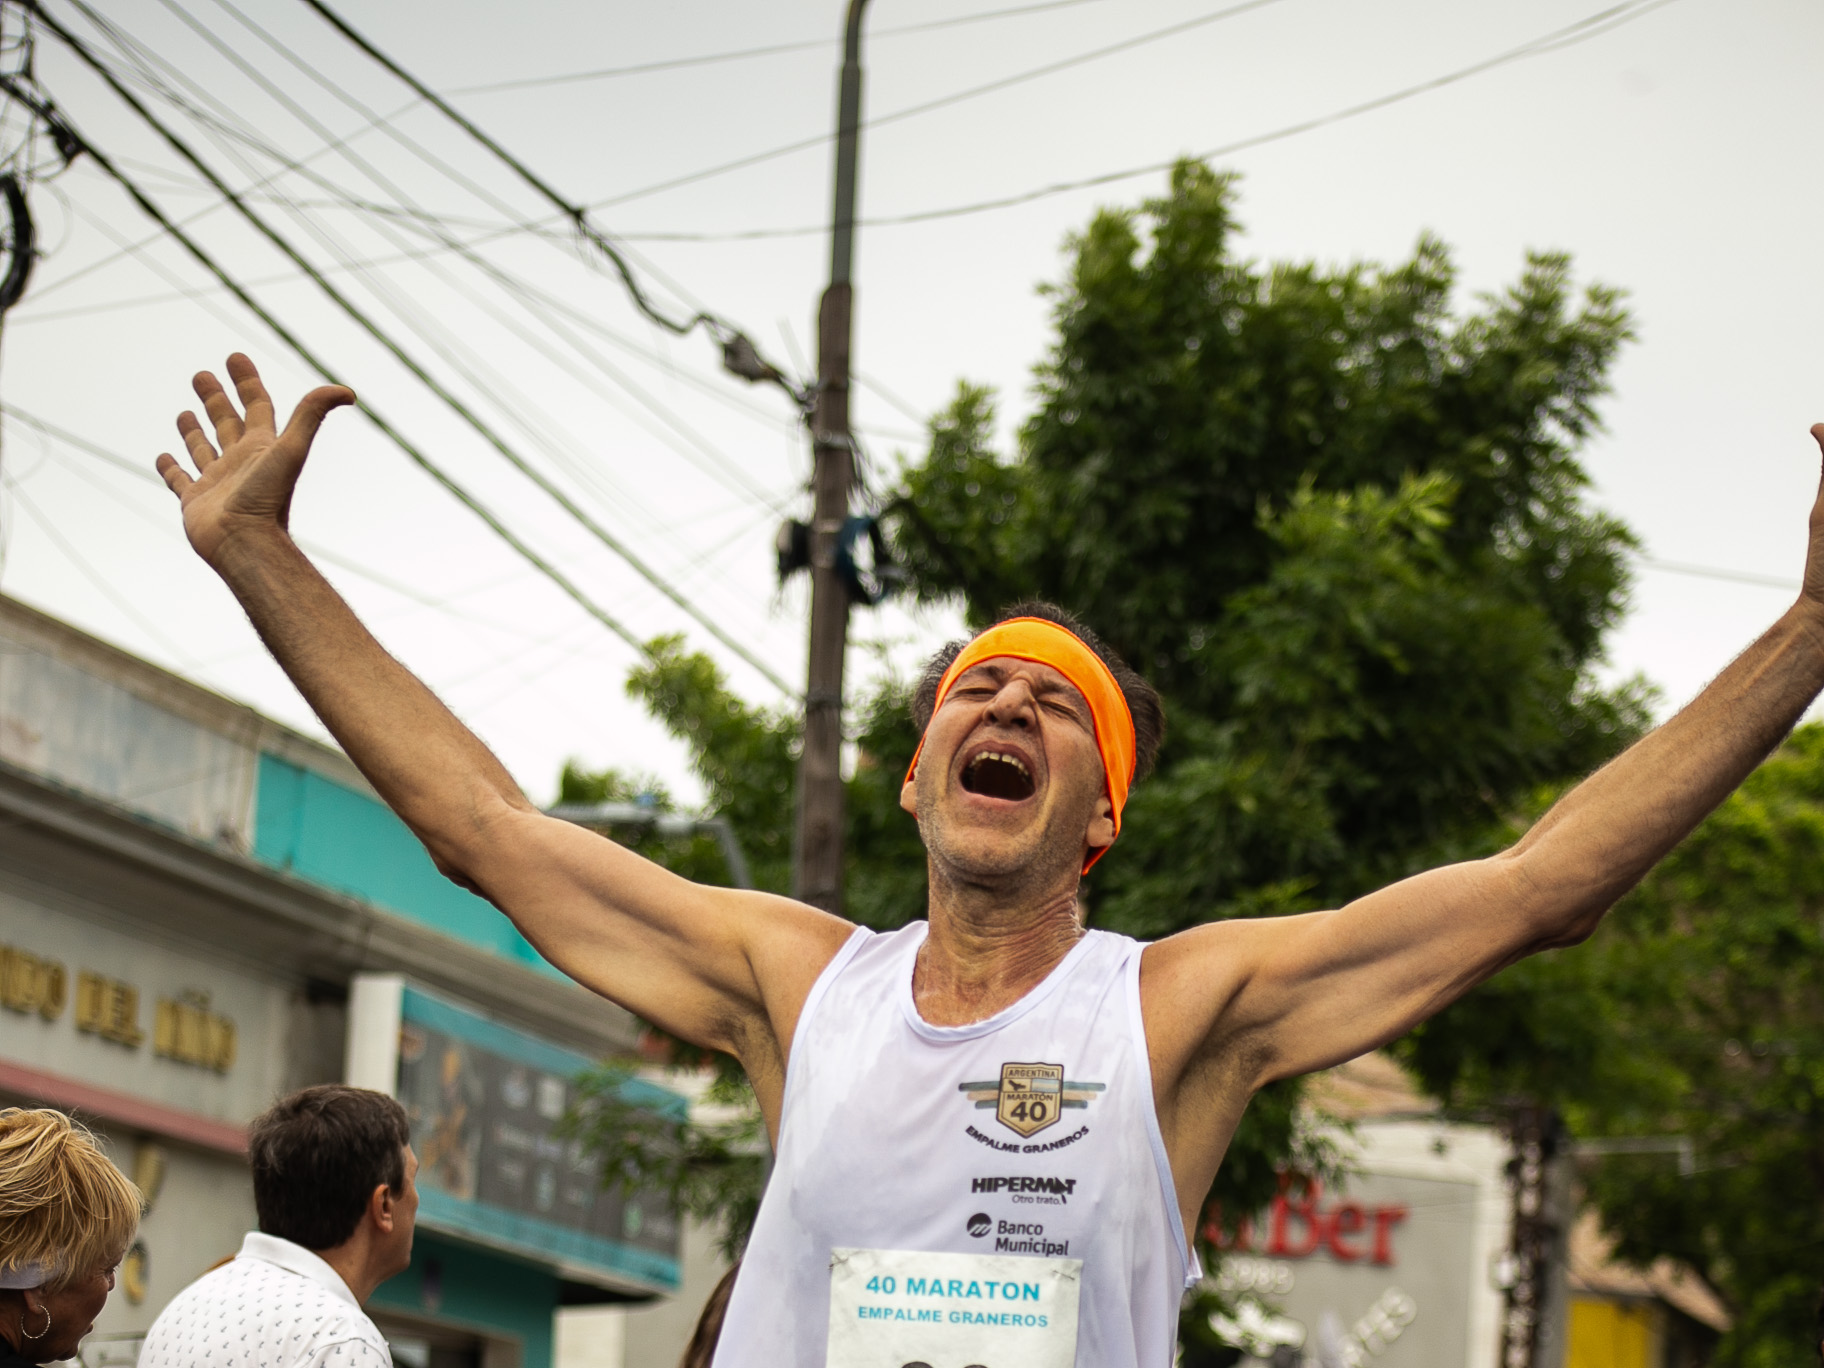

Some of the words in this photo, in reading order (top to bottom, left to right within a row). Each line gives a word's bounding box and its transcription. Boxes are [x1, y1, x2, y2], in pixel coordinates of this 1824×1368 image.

[1008, 1069, 1056, 1079] ARGENTINA
[1010, 1101, 1047, 1122] 40
[965, 1125, 1020, 1154] EMPALME
[1022, 1125, 1090, 1154] GRANEROS
[1011, 1194, 1033, 1205] Otro
[997, 1220, 1044, 1237] Banco
[995, 1237, 1070, 1257] Municipal
[865, 1275, 897, 1294] 40
[906, 1277, 1040, 1301] MARATON
[857, 1305, 943, 1324] EMPALME
[948, 1310, 1049, 1329] GRANEROS
